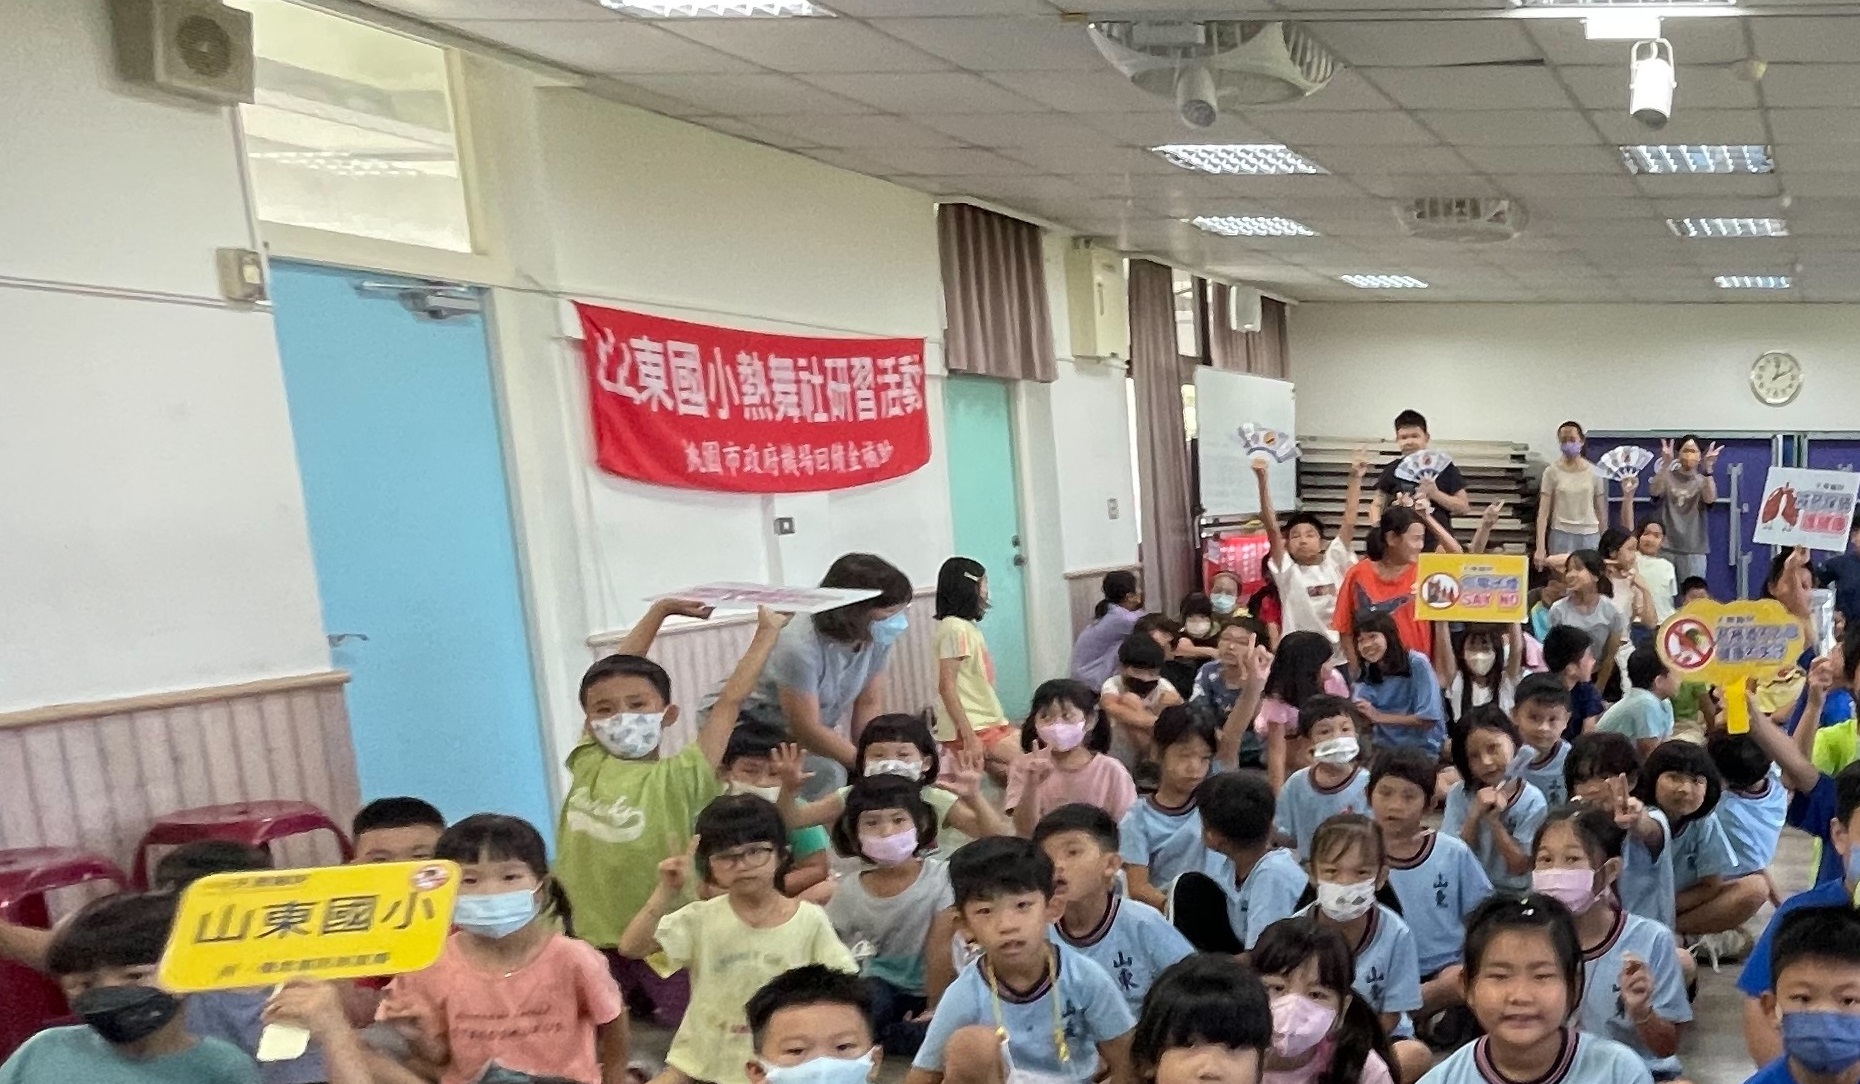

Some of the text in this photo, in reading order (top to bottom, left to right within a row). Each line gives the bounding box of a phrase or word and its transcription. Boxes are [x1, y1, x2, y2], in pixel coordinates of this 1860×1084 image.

[195, 892, 436, 944] 山東國小
[1113, 950, 1139, 991] 山東
